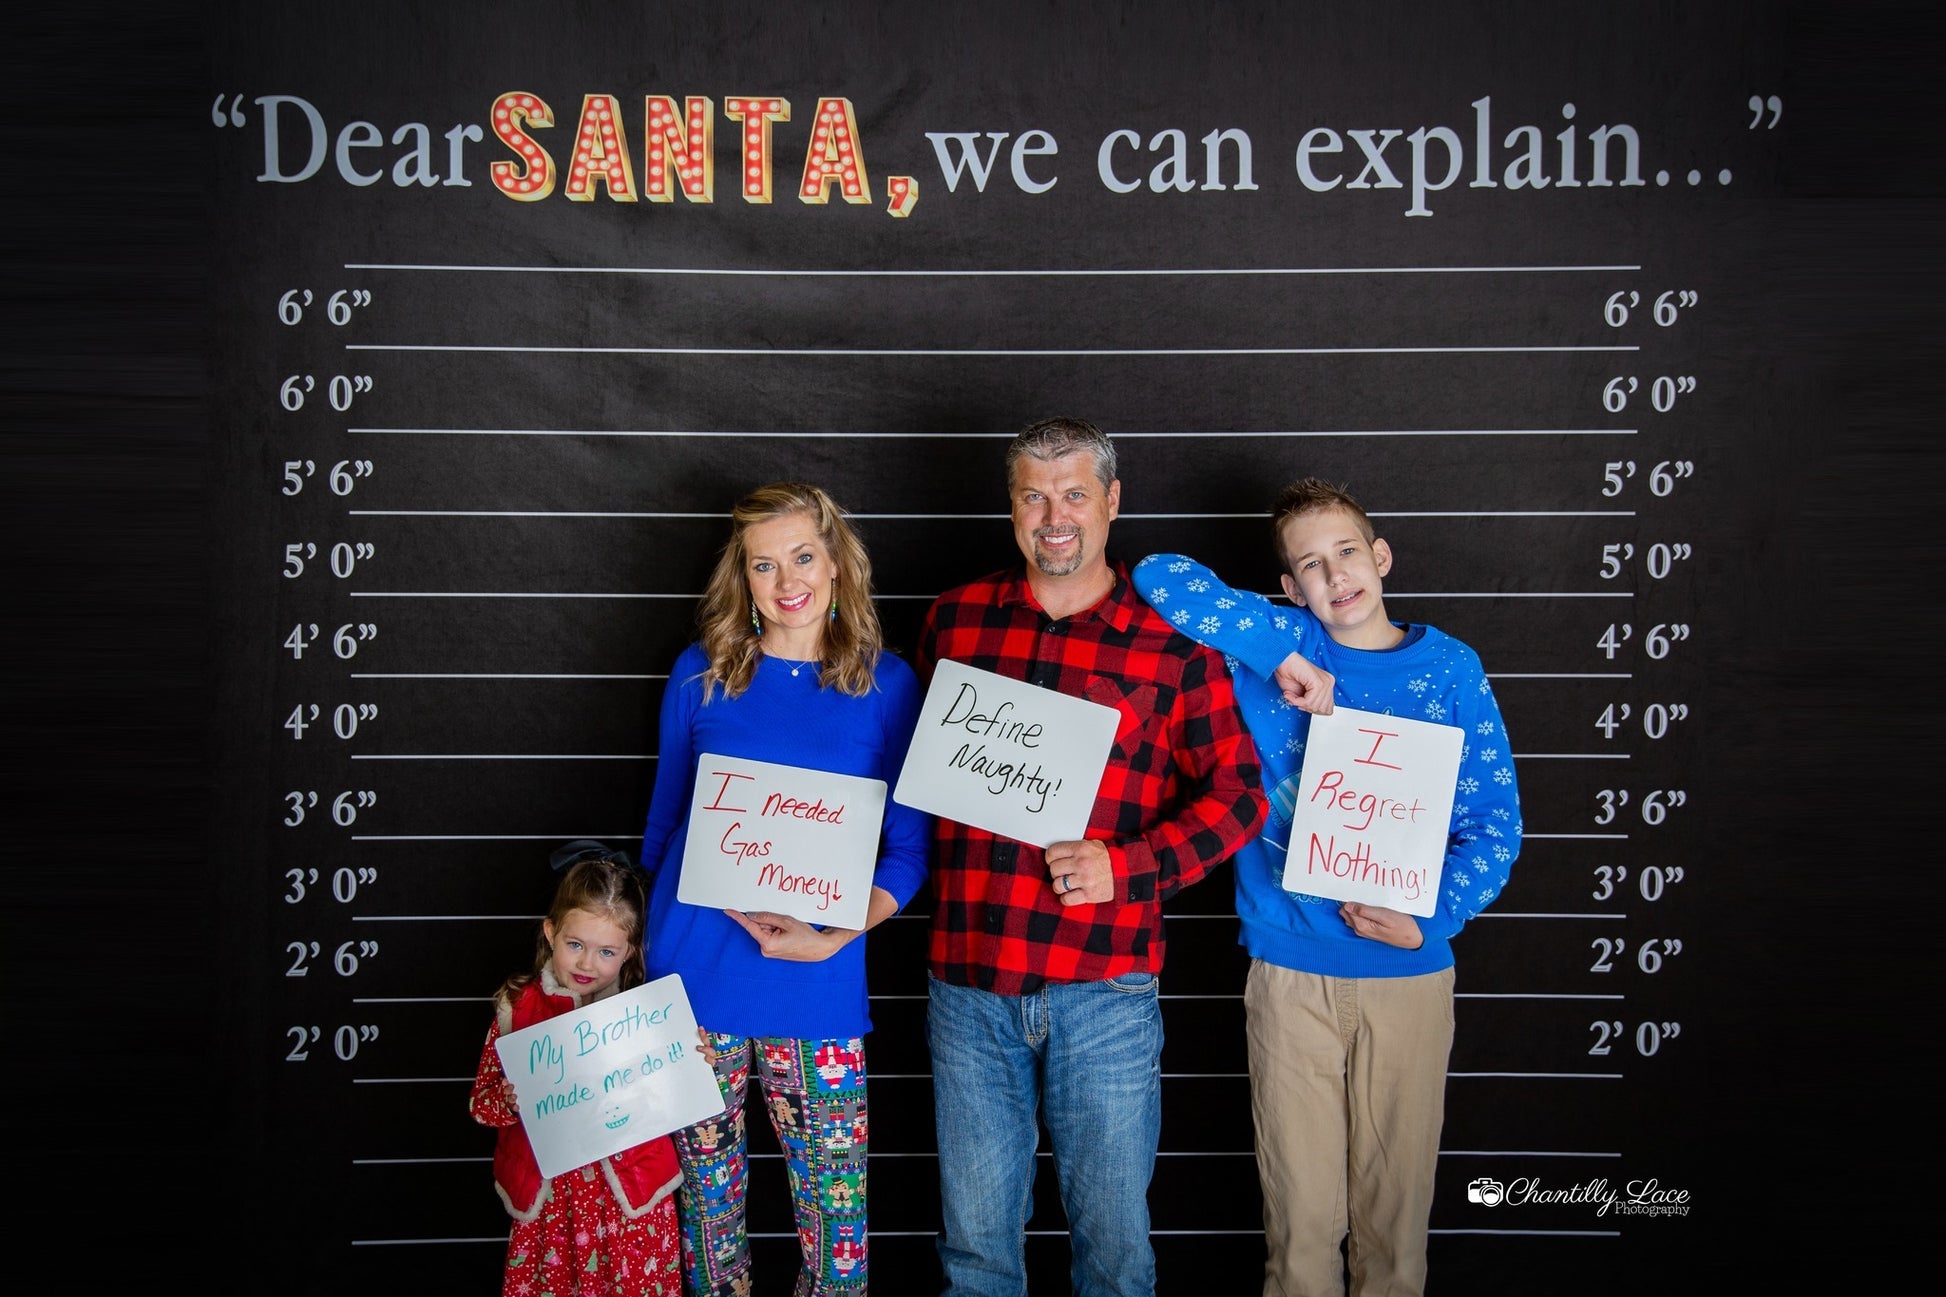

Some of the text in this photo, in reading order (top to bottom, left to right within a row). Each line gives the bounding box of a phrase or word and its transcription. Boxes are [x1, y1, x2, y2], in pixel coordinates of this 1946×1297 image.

[489, 90, 920, 219] SANTA,
[924, 129, 1059, 195] we
[1097, 128, 1260, 194] can
[940, 682, 1043, 749] Define
[1353, 728, 1402, 770] I
[702, 771, 845, 825] I needed
[948, 743, 1063, 813] Naughty!
[1311, 771, 1427, 831] Regret
[719, 822, 773, 866] Gas
[1308, 833, 1428, 901] Nothing!
[529, 1001, 674, 1085] My Brother
[536, 1041, 685, 1120] made me do it!
